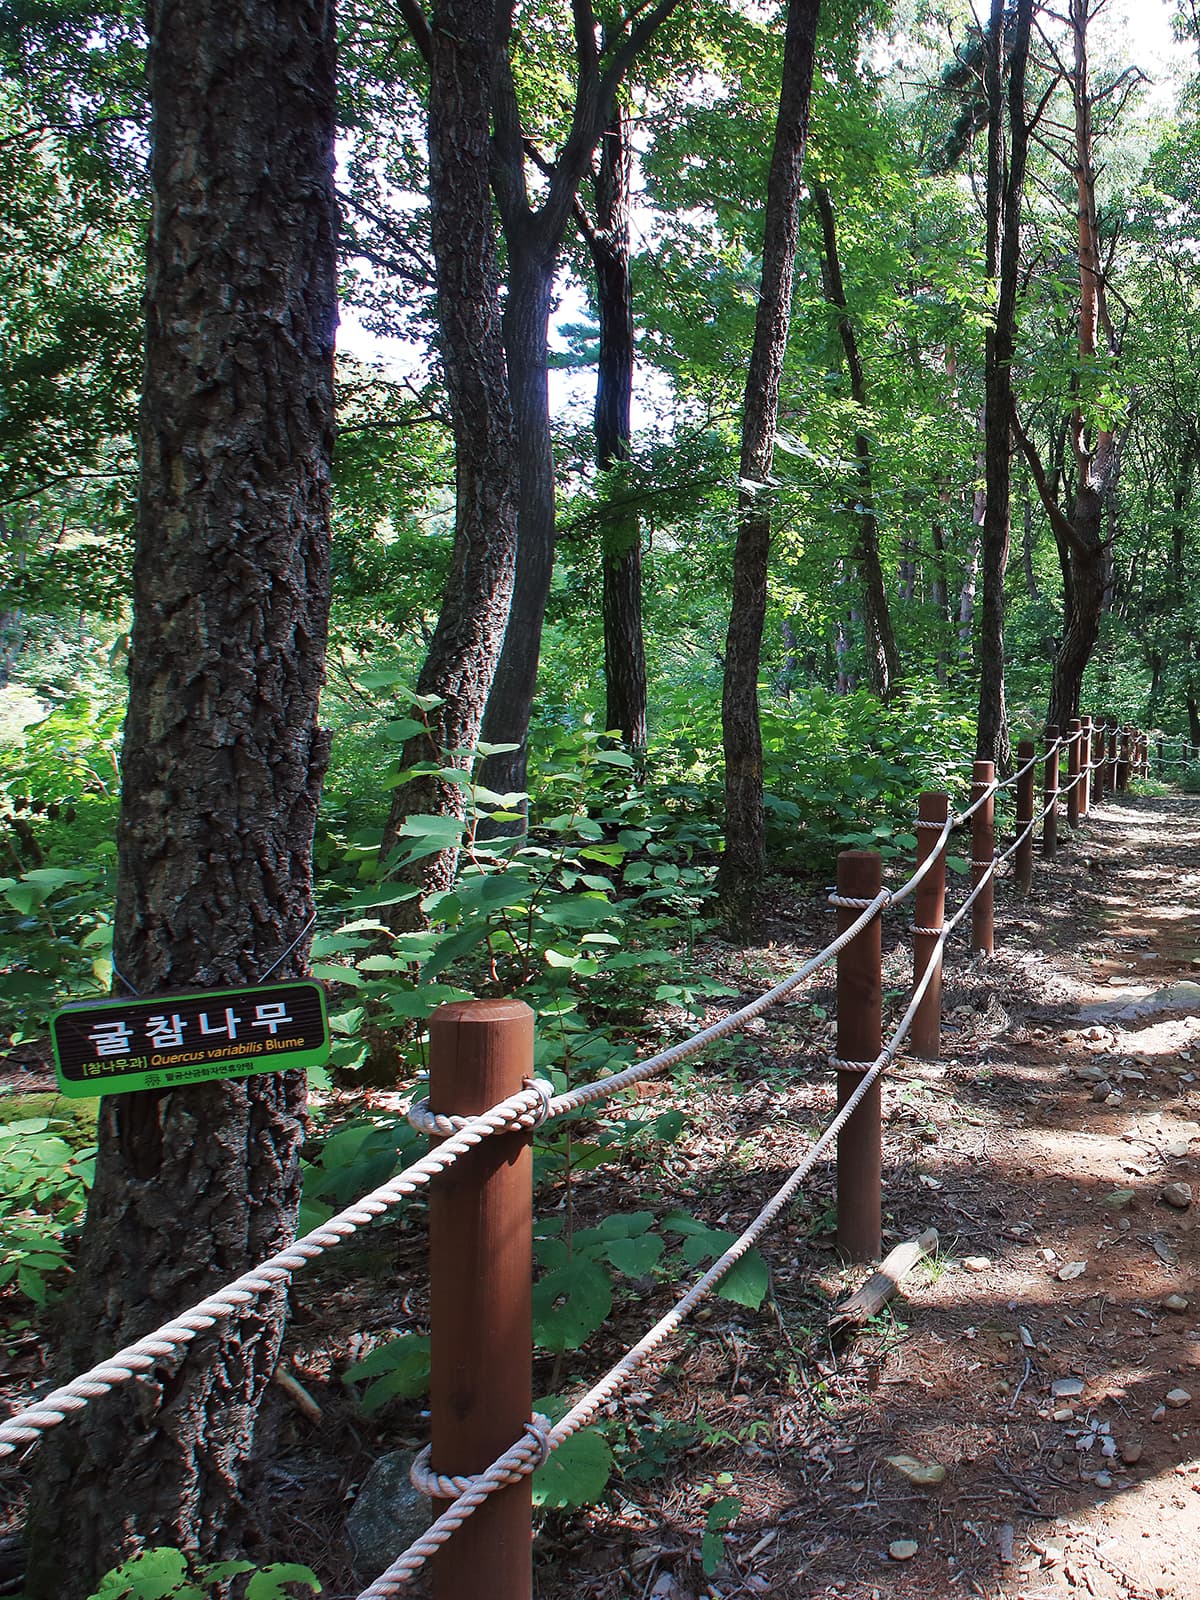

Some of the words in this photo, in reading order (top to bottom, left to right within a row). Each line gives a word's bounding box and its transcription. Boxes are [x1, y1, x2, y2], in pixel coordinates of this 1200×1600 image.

[88, 1002, 293, 1056] 굴참나무
[151, 1048, 205, 1067] Quercus
[206, 1041, 264, 1060] variabilis
[265, 1035, 305, 1052] Blume
